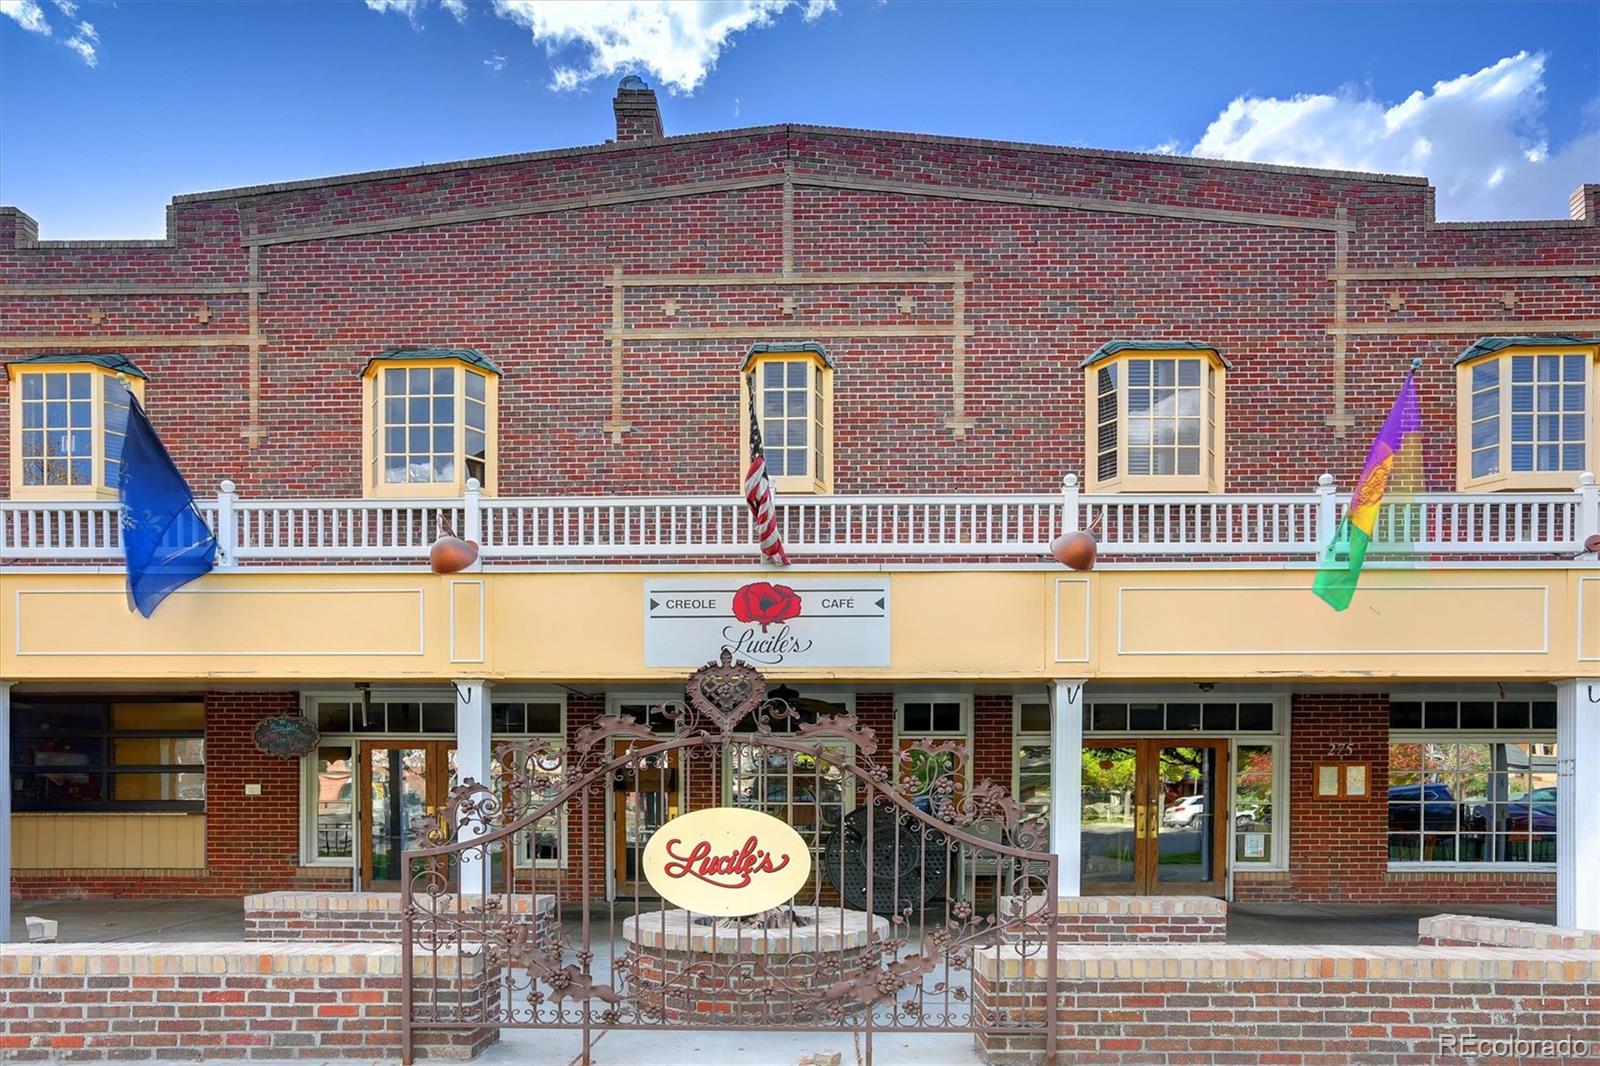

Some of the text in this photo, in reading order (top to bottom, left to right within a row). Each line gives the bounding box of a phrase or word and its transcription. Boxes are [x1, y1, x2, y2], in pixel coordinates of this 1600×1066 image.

[665, 596, 855, 610] CREOLE CAFÉ
[721, 625, 813, 665] Lucile's
[1327, 743, 1354, 756] 275
[664, 835, 790, 889] Lucile's
